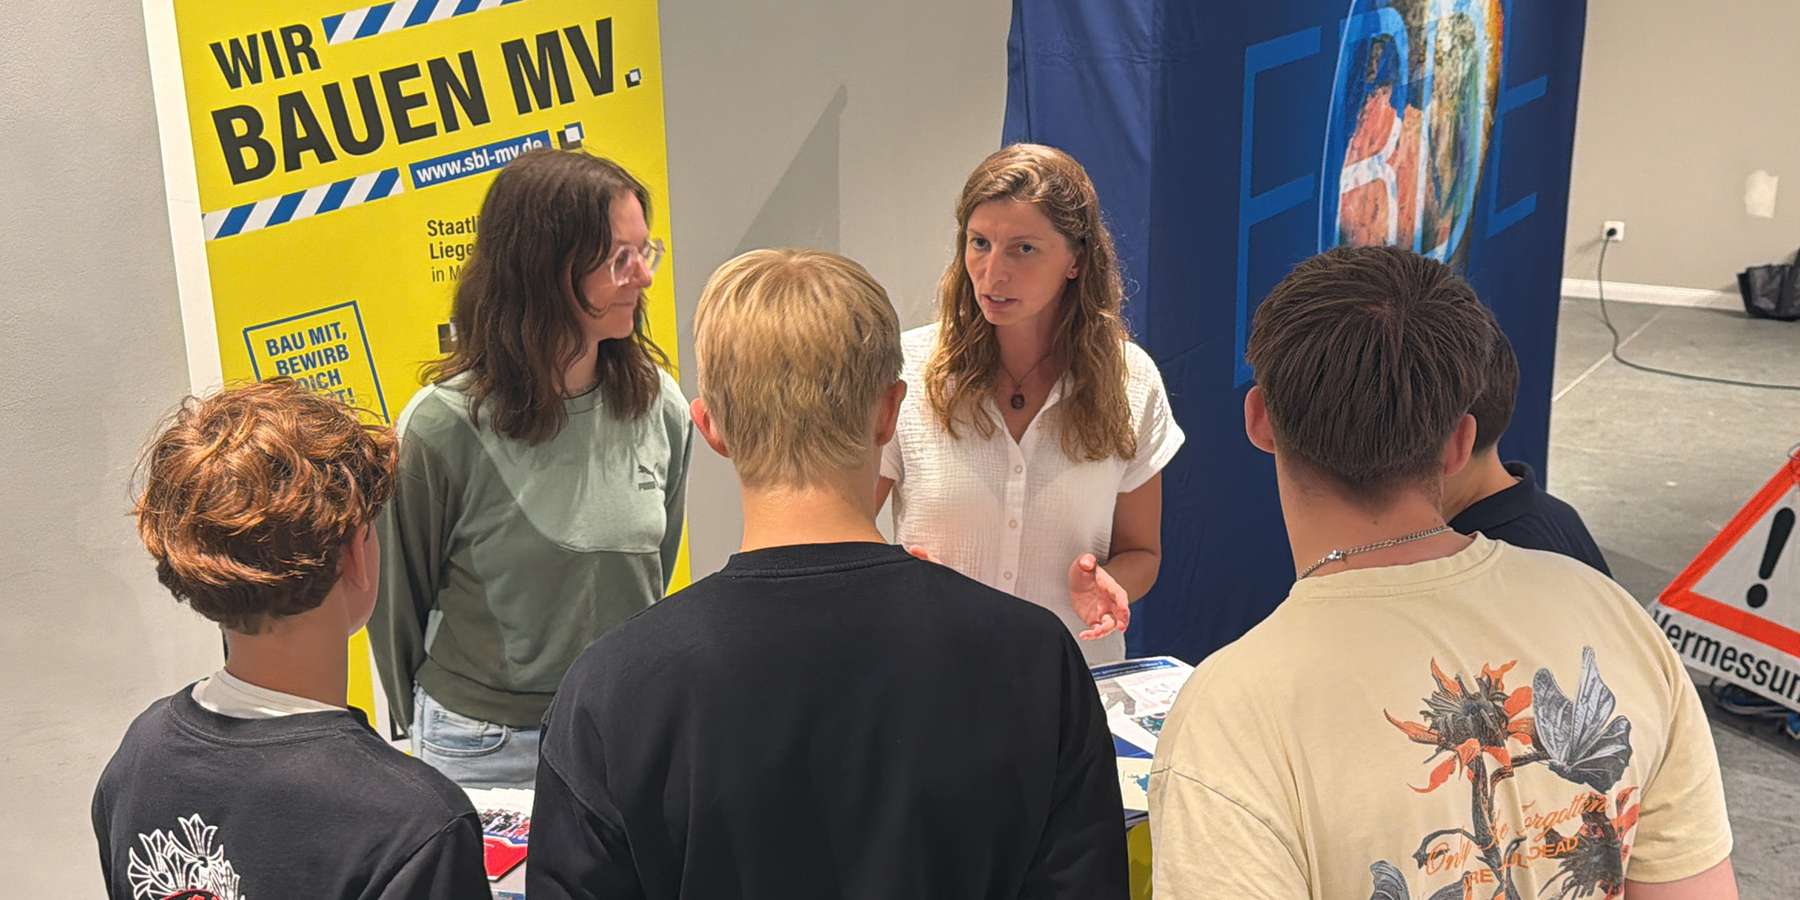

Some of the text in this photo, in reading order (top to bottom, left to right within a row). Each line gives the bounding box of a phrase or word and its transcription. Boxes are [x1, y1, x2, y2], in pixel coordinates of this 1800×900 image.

[210, 24, 320, 89] WIR
[211, 50, 491, 185] BAUEN
[431, 266, 445, 282] in
[265, 321, 348, 357] BAU MIT,
[276, 343, 350, 376] BEWIRB
